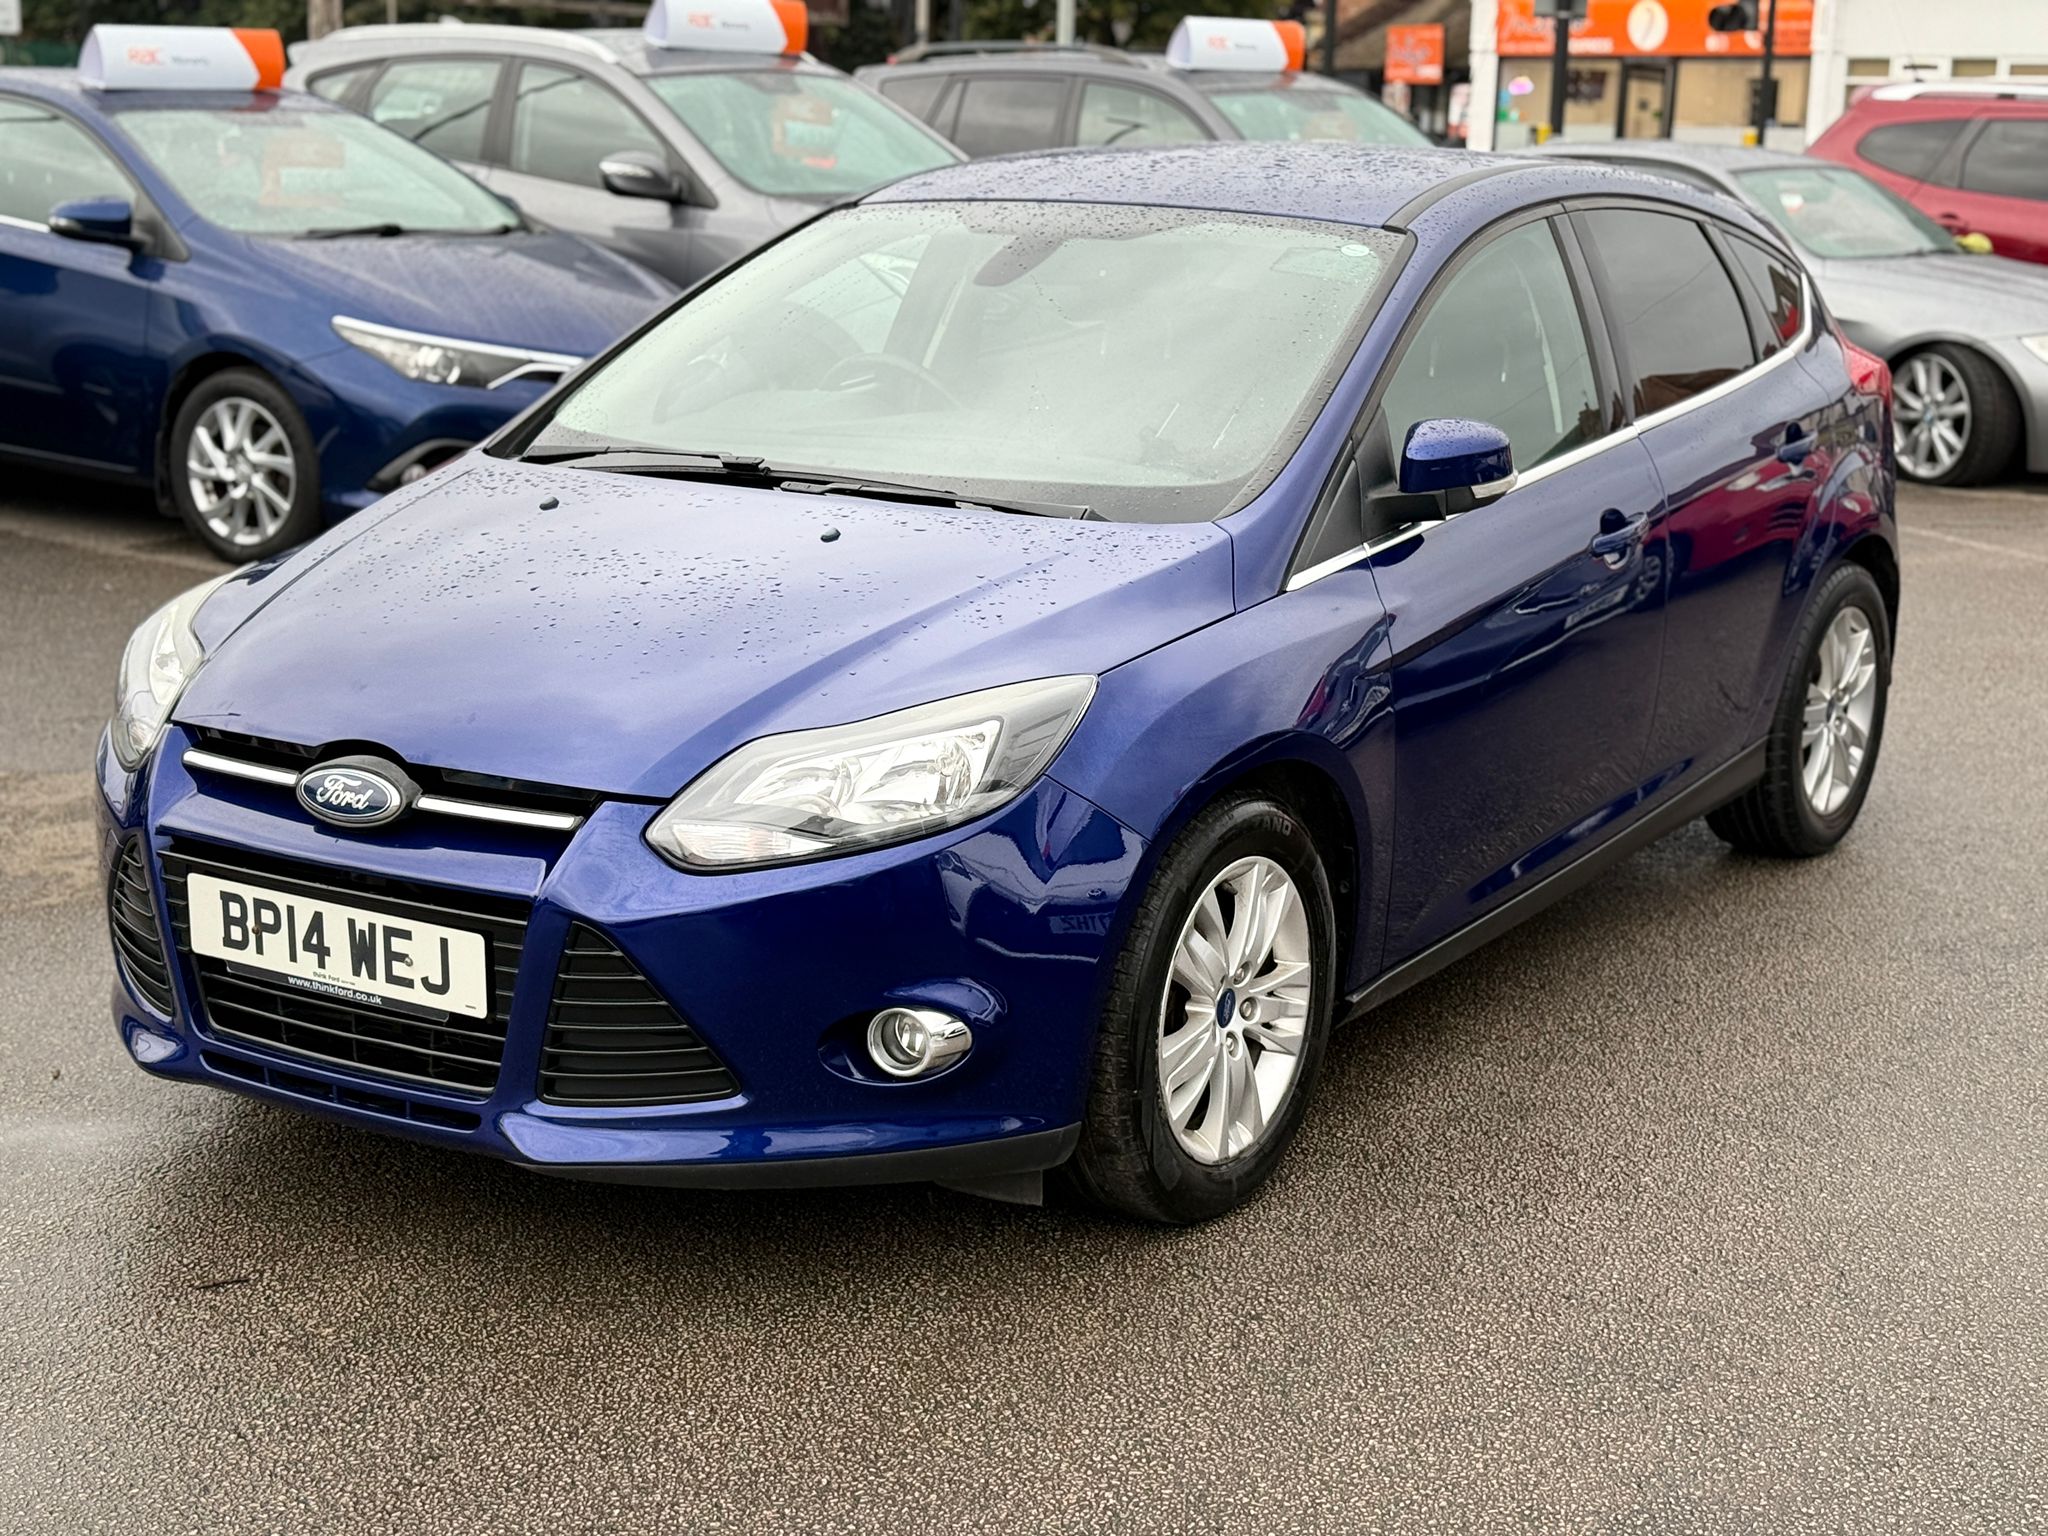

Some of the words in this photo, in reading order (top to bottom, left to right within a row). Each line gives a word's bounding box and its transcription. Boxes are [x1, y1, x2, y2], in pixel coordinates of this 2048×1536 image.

[316, 774, 375, 810] Ford
[219, 890, 331, 970] BP14
[347, 917, 451, 996] WEJ
[288, 976, 382, 1004] www.thinkford.co.uk
